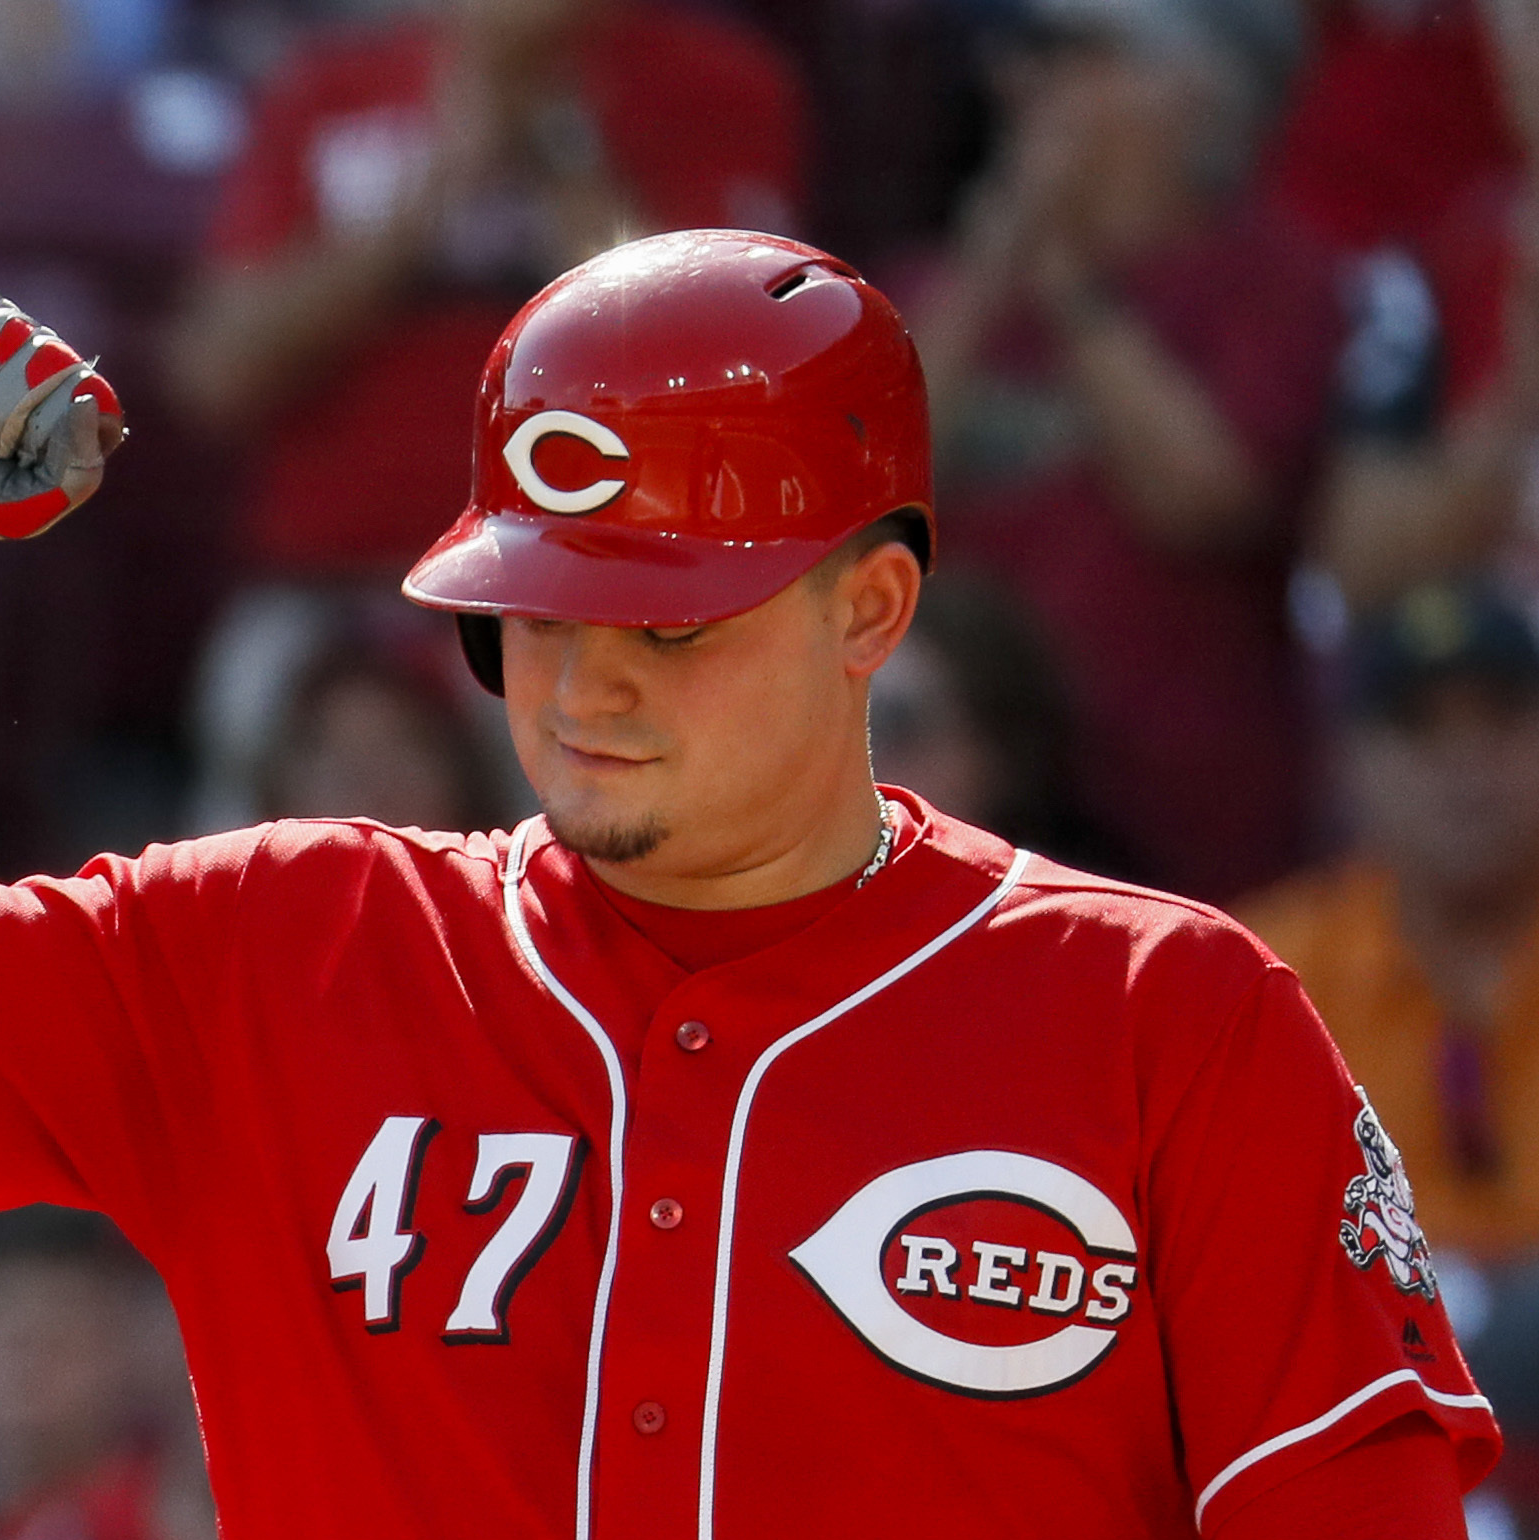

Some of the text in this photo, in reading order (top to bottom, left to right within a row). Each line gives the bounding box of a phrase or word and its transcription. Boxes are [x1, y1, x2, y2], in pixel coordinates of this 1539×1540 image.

[503, 410, 630, 516] C
[326, 1114, 592, 1347] 47
[895, 1233, 1138, 1324] REDS
